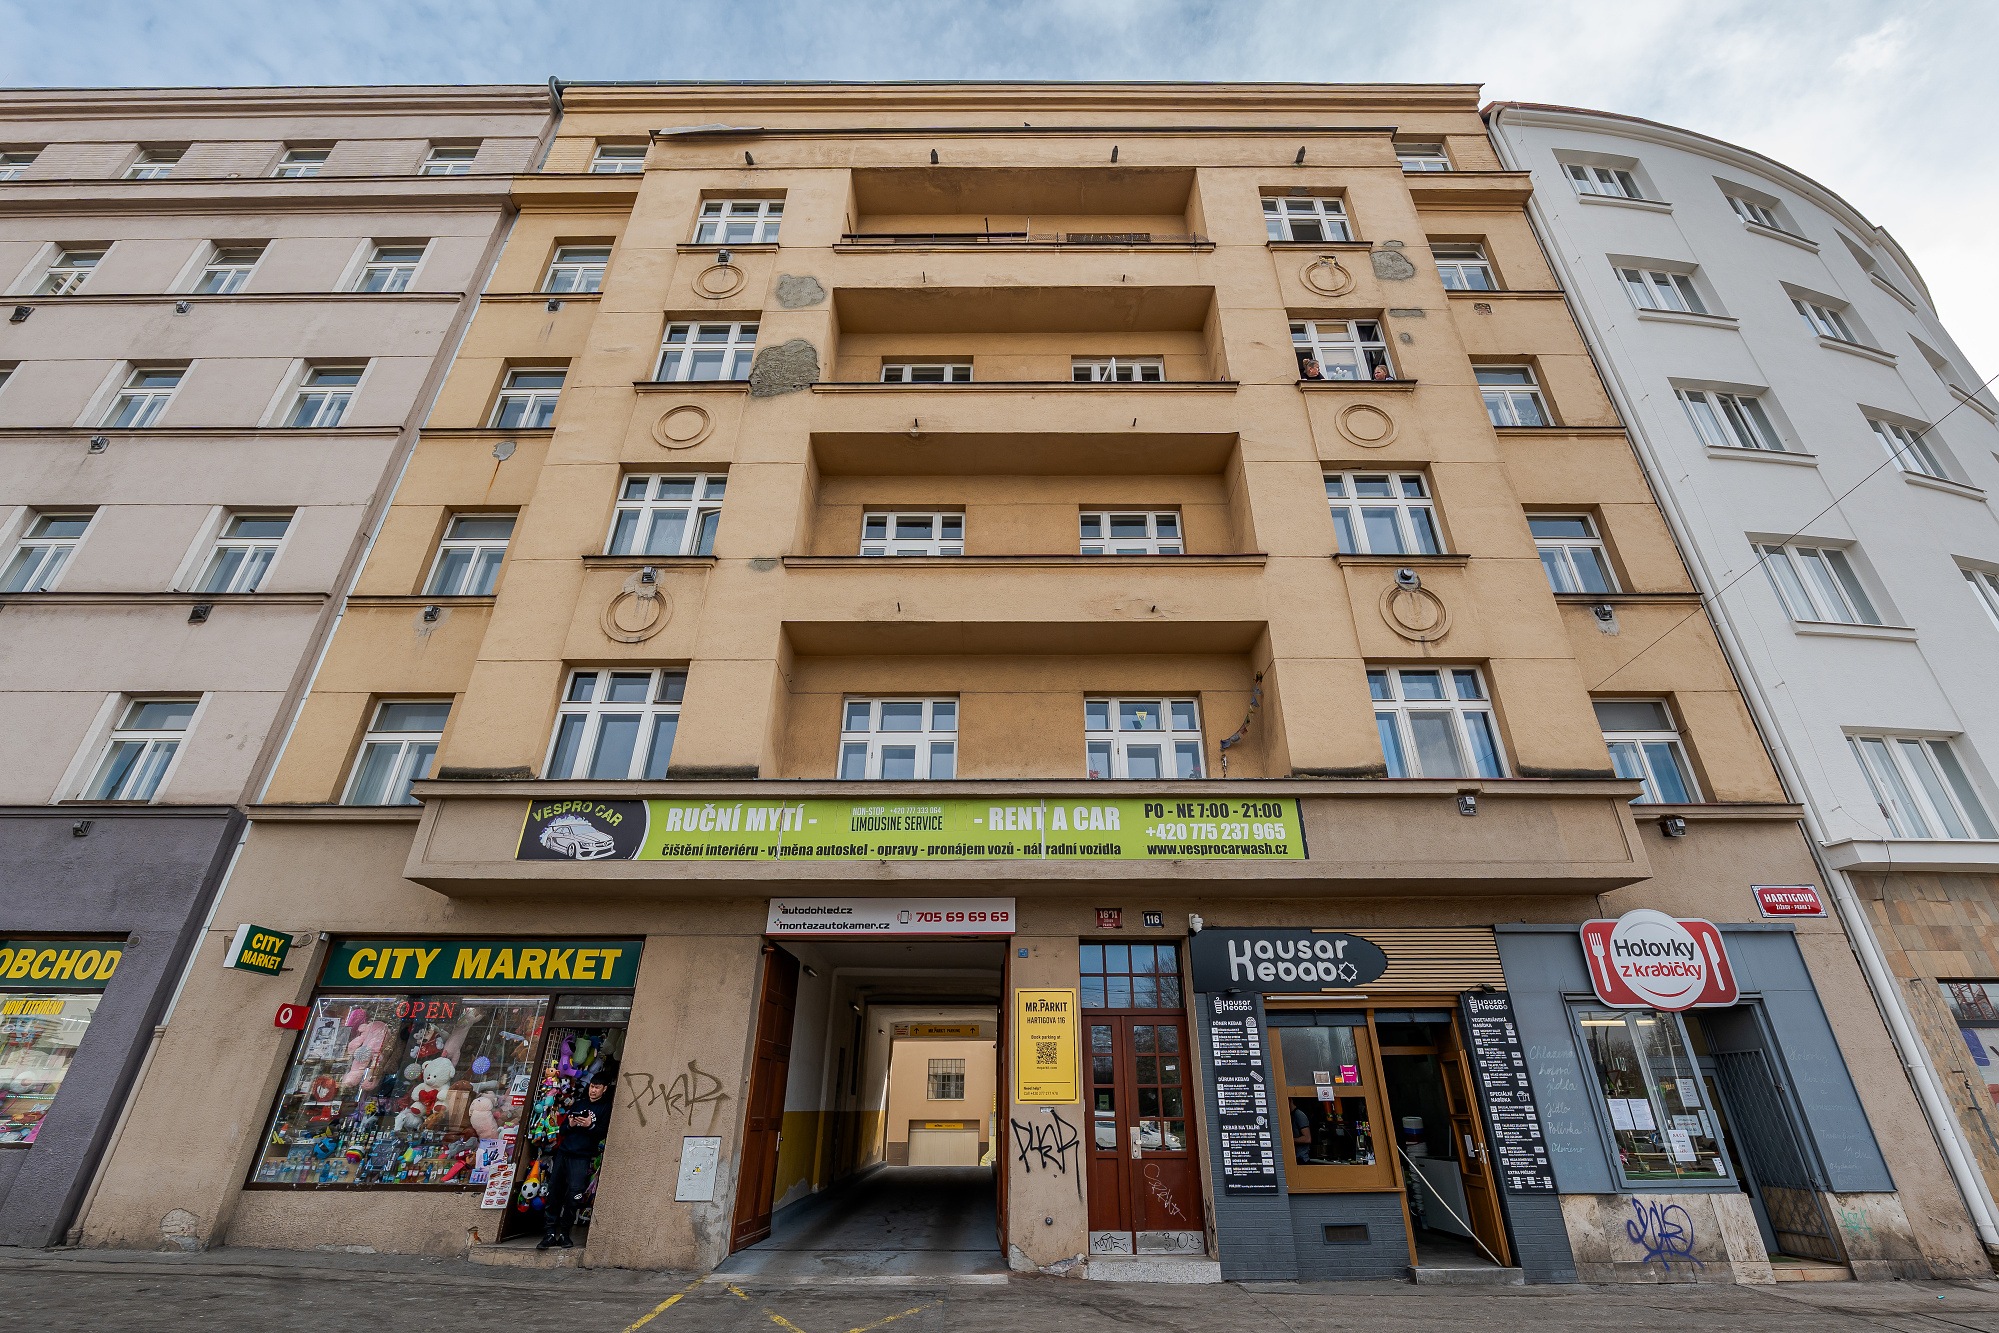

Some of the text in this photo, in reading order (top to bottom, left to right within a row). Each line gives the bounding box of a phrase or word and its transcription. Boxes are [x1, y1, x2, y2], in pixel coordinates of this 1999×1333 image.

[532, 801, 624, 827] VESPRO CAR
[665, 804, 741, 831] RUČNÍ
[745, 804, 806, 831] MYTÍ
[852, 806, 942, 816] NON-STOP +420 777 333 064
[989, 806, 1046, 831] RENT
[1052, 808, 1068, 831] A
[1073, 807, 1121, 831] CAR
[1144, 803, 1164, 818] PO
[1176, 804, 1195, 818] NE
[1197, 803, 1229, 818] 7:00
[1241, 803, 1283, 818] 21:00
[851, 816, 943, 832] LIMOUSINE SERVICE
[1145, 823, 1286, 840] +420 775 237 965
[662, 843, 703, 857] čištění
[705, 844, 759, 857] interiéru
[816, 843, 868, 857] autoskel
[877, 845, 918, 858] opravy
[928, 843, 985, 857] pronájem
[988, 842, 1014, 856] vozů
[1079, 843, 1121, 855] vozidla
[1147, 843, 1288, 856] www.vesprocarwash.cz
[1763, 893, 1816, 902] HARTIGOVA
[782, 906, 853, 914] autodohled.cz
[916, 911, 1009, 923] 705 69 69 69
[779, 921, 890, 931] montazautokamer.cz
[1146, 915, 1160, 924] 116
[252, 933, 285, 953] CITY
[1613, 939, 1695, 961] Hotovky
[241, 950, 282, 970] MARKET
[348, 948, 442, 979] CITY
[452, 948, 622, 980] MARKET
[1620, 962, 1701, 980] z krabičky
[396, 1002, 456, 1019] OPEN
[1025, 1001, 1068, 1012] MR.PARKIT
[1026, 1016, 1057, 1024] HARTIGOVA
